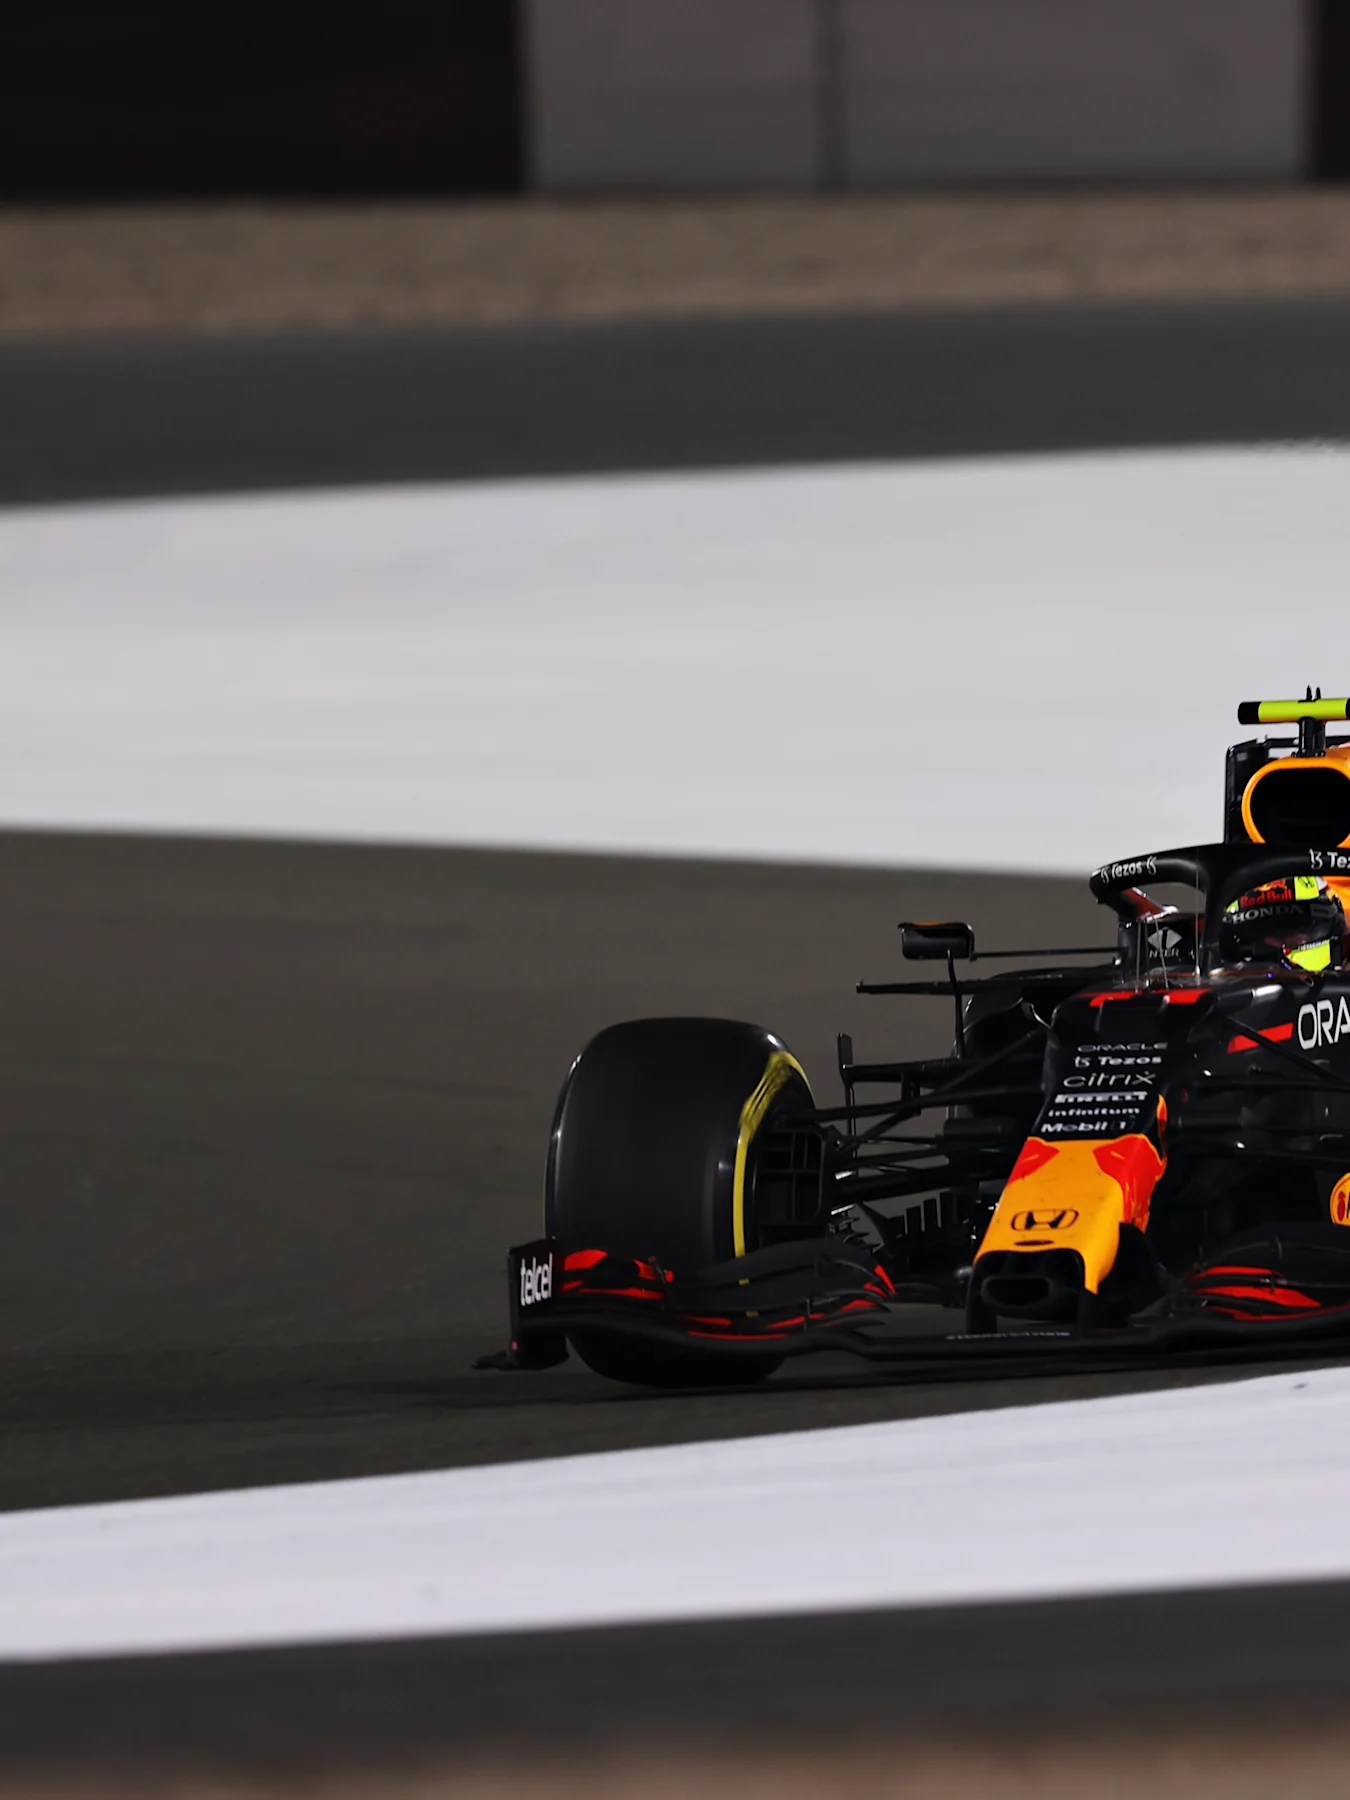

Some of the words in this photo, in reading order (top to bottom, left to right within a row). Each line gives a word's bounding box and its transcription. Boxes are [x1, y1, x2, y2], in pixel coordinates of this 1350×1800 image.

[1111, 860, 1143, 881] Tezos
[1240, 892, 1265, 908] Red
[1266, 888, 1293, 902] Bull
[1232, 904, 1304, 924] HONDA
[1077, 1042, 1169, 1053] ORACLE
[1098, 1056, 1162, 1066] Tezos
[1063, 1071, 1156, 1088] citrix
[1048, 1107, 1140, 1117] infinitum
[1041, 1121, 1108, 1133] Mobil
[521, 1252, 553, 1306] telcel
